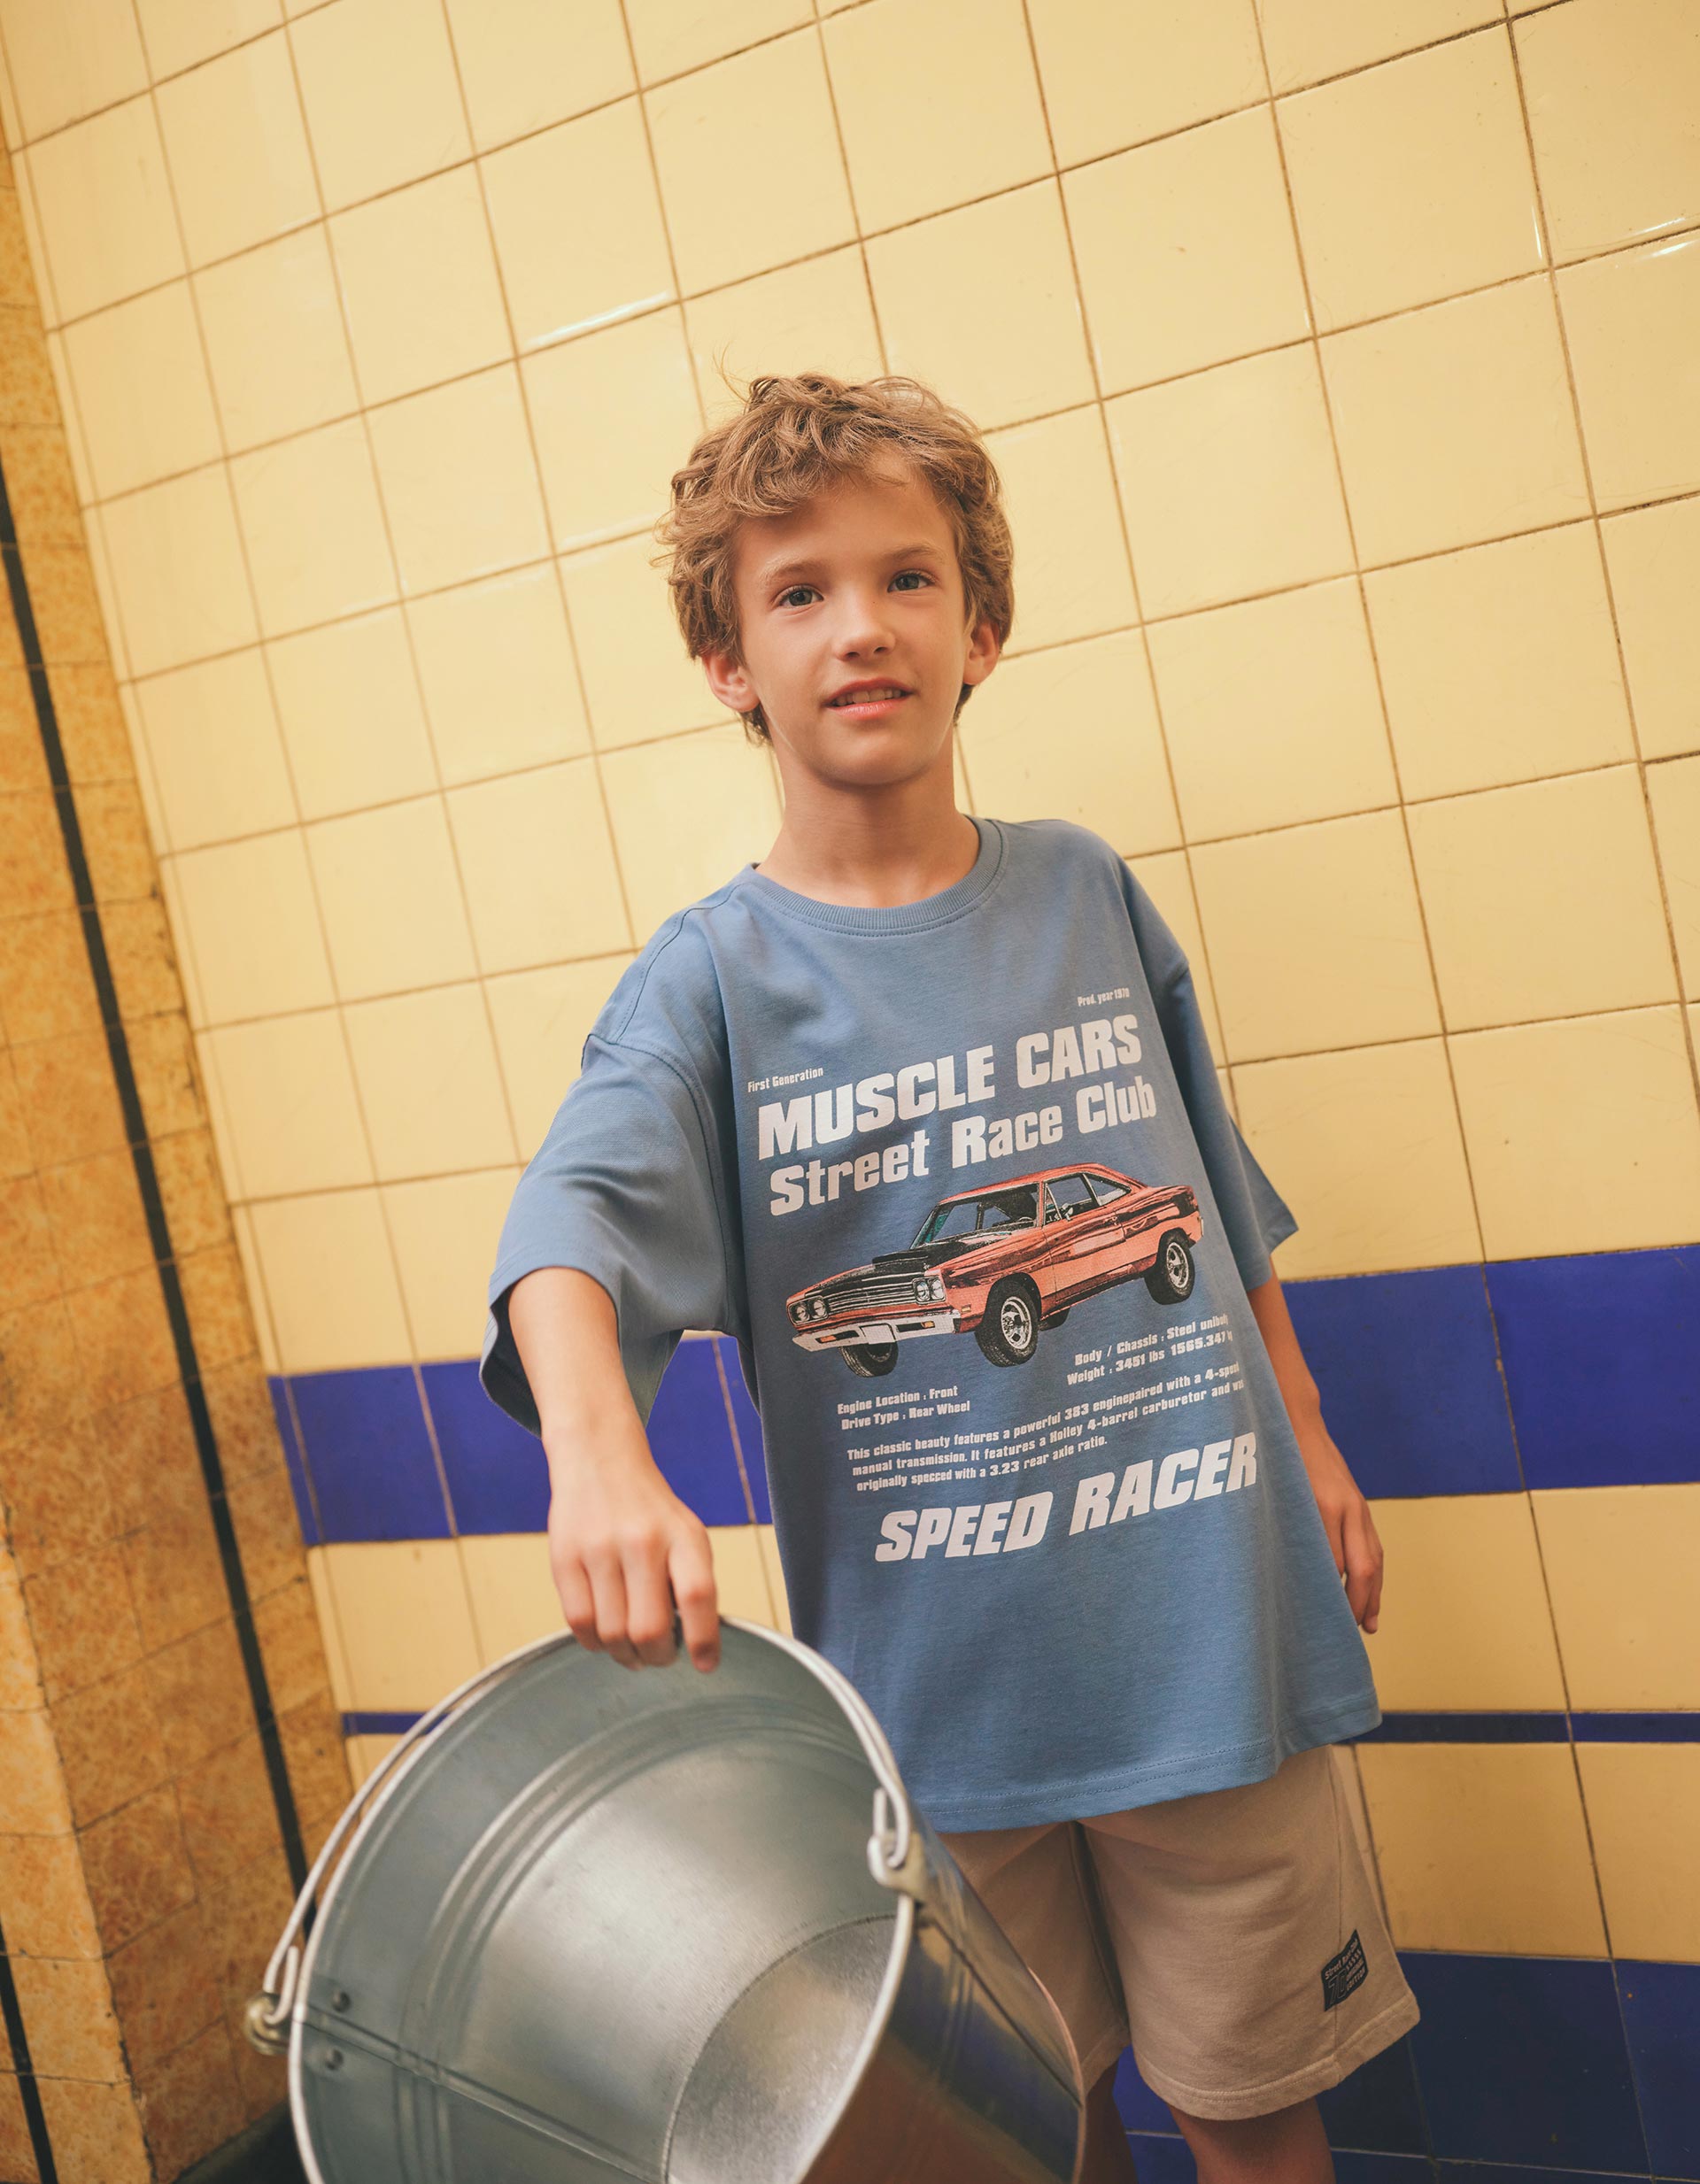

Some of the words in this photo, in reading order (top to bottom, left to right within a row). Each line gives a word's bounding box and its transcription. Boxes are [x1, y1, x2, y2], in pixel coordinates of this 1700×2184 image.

[1077, 993, 1096, 1007] Prod.
[1097, 991, 1114, 1005] year
[1114, 987, 1130, 999] 1970
[747, 1077, 770, 1093] First
[772, 1067, 824, 1087] Generation
[758, 1045, 995, 1160] MUSCLE
[1016, 1014, 1142, 1090] CARS
[769, 1130, 931, 1216] Street
[952, 1105, 1063, 1169] Race
[1075, 1076, 1157, 1134] Club
[1067, 1365, 1105, 1385] Weight
[1115, 1354, 1146, 1372] 3451
[1148, 1349, 1165, 1363] lbs
[1074, 1350, 1102, 1366] Body
[1117, 1333, 1158, 1354] Chassis
[1166, 1322, 1196, 1339] Steel
[837, 1400, 872, 1415] Engine
[876, 1392, 920, 1408] Location
[929, 1385, 958, 1400] Front
[841, 1416, 871, 1430] Drive
[873, 1411, 900, 1425] Type
[908, 1406, 934, 1419] Rear
[937, 1401, 970, 1416] Wheel
[847, 1448, 870, 1461] This
[873, 1440, 911, 1456] classic
[915, 1436, 950, 1450] beauty
[954, 1431, 1000, 1446] features
[1002, 1429, 1010, 1439] a
[1013, 1412, 1061, 1439] powerful
[1064, 1402, 1090, 1420] 383
[1166, 1375, 1191, 1392] with
[1194, 1373, 1202, 1385] a
[852, 1459, 892, 1477] manual
[896, 1452, 968, 1470] transmission.
[970, 1449, 980, 1461] It
[984, 1439, 1036, 1460] features
[1039, 1437, 1047, 1447] a
[1049, 1424, 1083, 1444] Holley
[1086, 1407, 1138, 1431] 4-barrel
[1142, 1390, 1207, 1416] carburetor
[1211, 1381, 1231, 1397] and
[856, 1475, 908, 1492] originally
[911, 1469, 953, 1486] specced
[954, 1467, 977, 1480] with
[979, 1468, 986, 1478] a
[989, 1460, 1020, 1477] 3.23
[1024, 1453, 1050, 1470] rear
[1052, 1443, 1075, 1460] axle
[1078, 1435, 1108, 1452] ratio.
[875, 1491, 1054, 1562] SPEED
[1069, 1432, 1257, 1536] RACER
